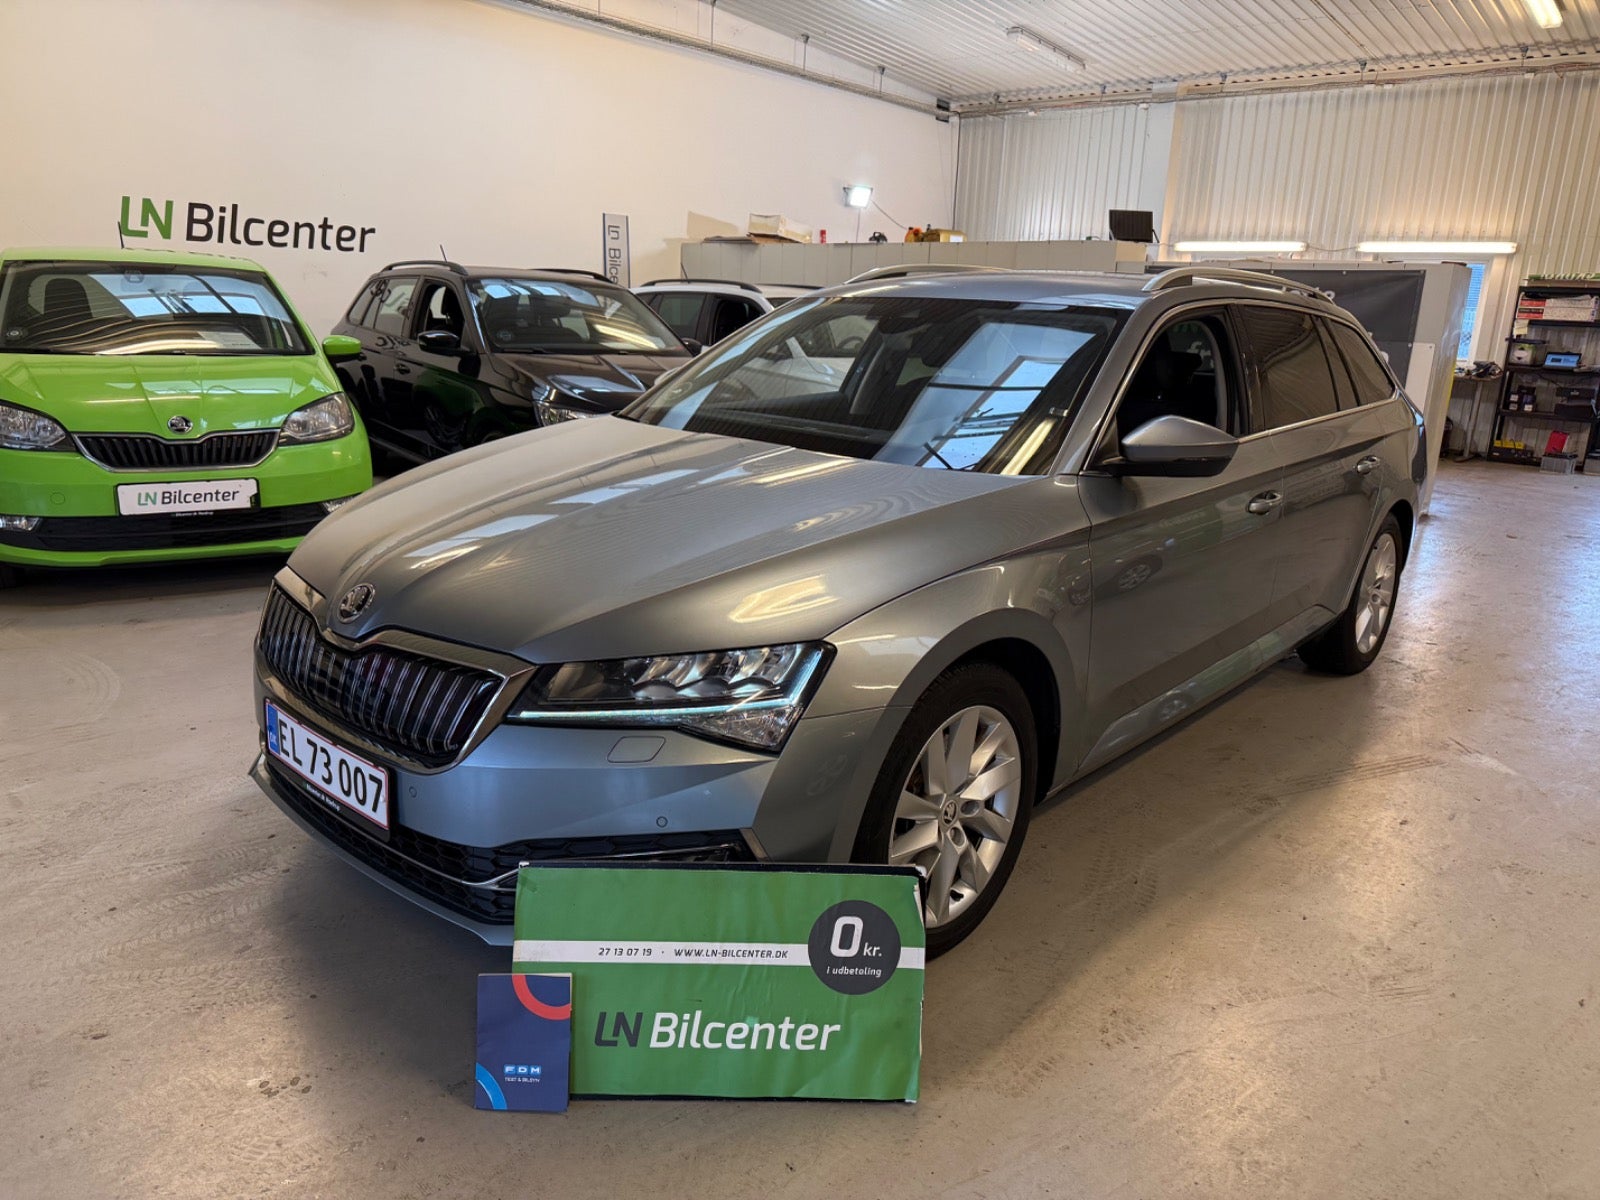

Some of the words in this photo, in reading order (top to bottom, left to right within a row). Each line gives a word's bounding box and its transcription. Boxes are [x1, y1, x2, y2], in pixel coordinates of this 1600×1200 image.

[120, 195, 174, 241] LN
[186, 202, 376, 253] Bilcenter
[137, 491, 158, 507] LN
[161, 489, 240, 505] Bilcenter
[278, 718, 303, 767] EL
[306, 737, 333, 785] 73
[338, 758, 383, 813] 007
[829, 915, 864, 958] 0
[863, 942, 883, 957] kr.
[598, 947, 611, 957] 27
[614, 947, 624, 957] 13
[626, 948, 639, 957] 07
[642, 948, 653, 957] 19
[673, 948, 789, 959] WWW.LN-BILCENTER.DK
[826, 965, 831, 975] i
[832, 966, 882, 978] udbetaling
[594, 1011, 644, 1048] LN
[649, 1009, 841, 1051] Bilcenter
[504, 1065, 541, 1075] FDM
